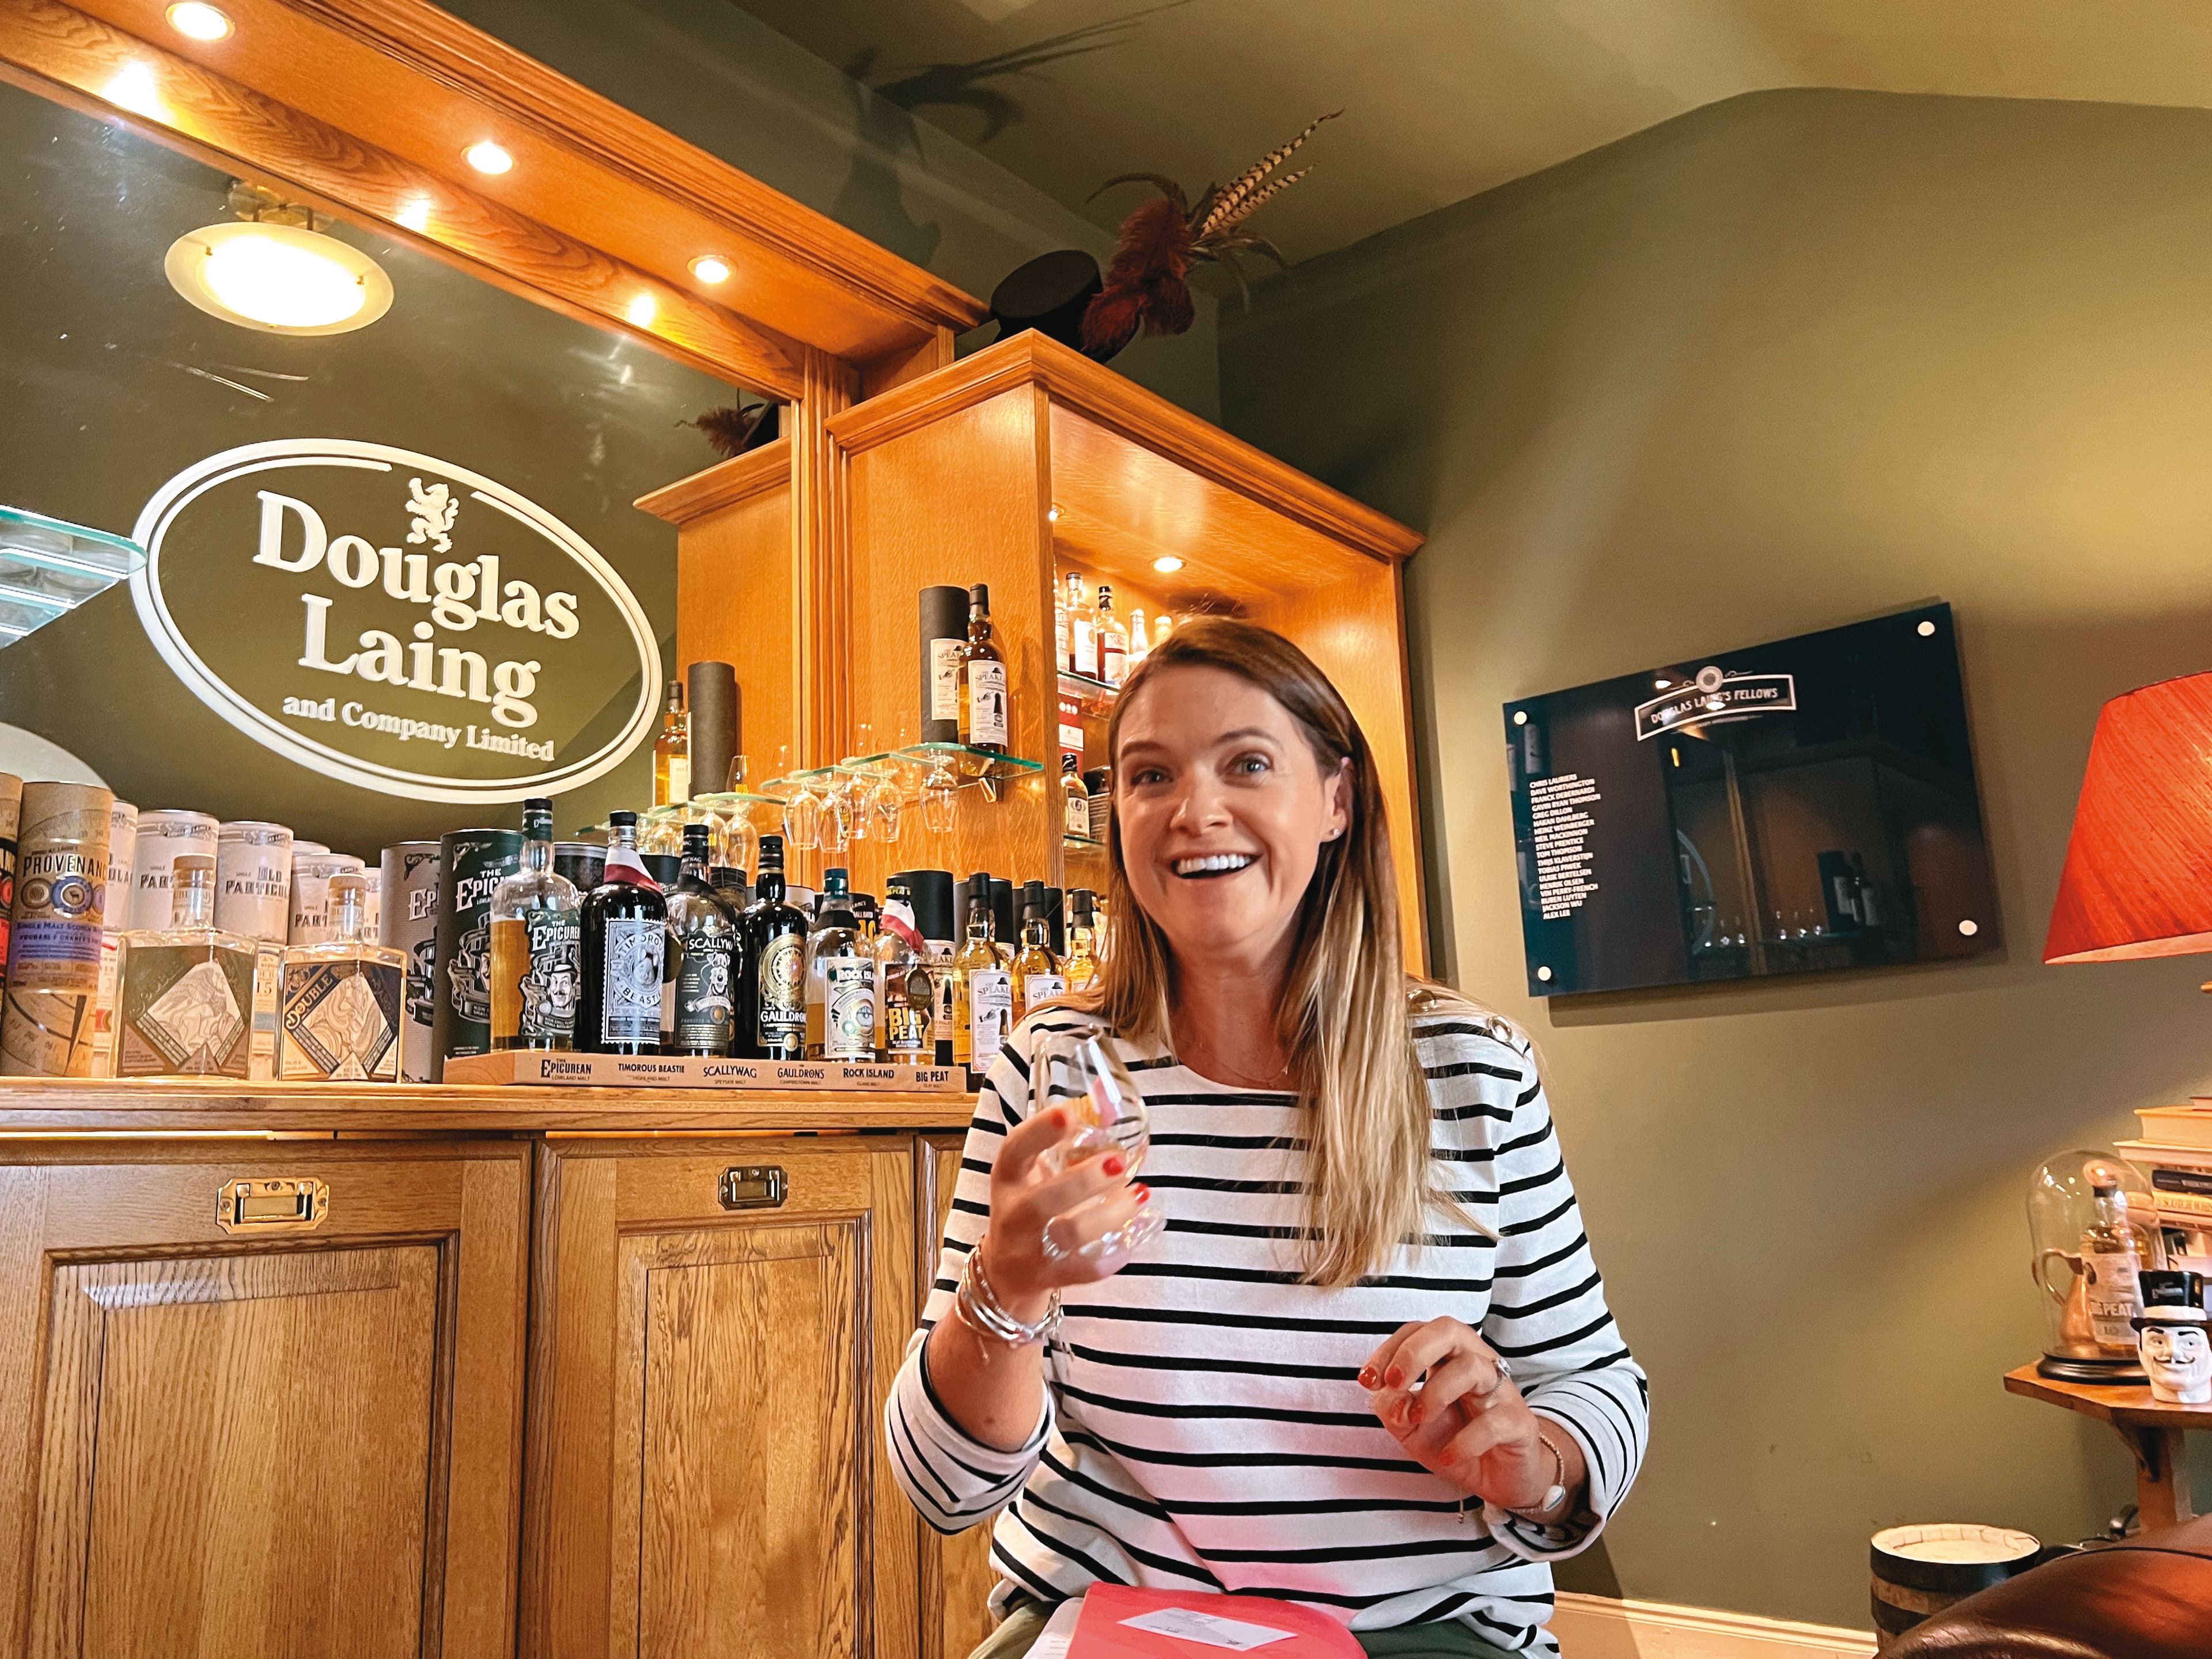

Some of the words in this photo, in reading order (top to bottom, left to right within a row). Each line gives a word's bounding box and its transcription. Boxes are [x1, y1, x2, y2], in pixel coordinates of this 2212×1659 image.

[253, 489, 579, 639] Douglas
[298, 592, 542, 728] Laing
[1650, 700, 1693, 724] DOGLAS
[1734, 688, 1779, 700] FELLOWS
[282, 693, 336, 722] and
[341, 702, 462, 749] Company
[465, 724, 555, 762] Limited
[1531, 788, 1547, 796] DAVE
[1531, 794, 1555, 804] FRANCK
[1532, 802, 1551, 812] GAVIN
[1551, 800, 1569, 808] RYAN
[1569, 793, 1601, 805] THOMSON
[1532, 811, 1550, 820] GREG
[1550, 807, 1573, 816] DILLON
[1555, 812, 1589, 824] DAHLBERG
[1534, 826, 1554, 835] HEINZ
[1553, 819, 1595, 832] WEINBERGER
[1535, 835, 1549, 843] NEIL
[1549, 828, 1588, 840] MACKINNON
[1535, 842, 1554, 851] STEVE
[1554, 837, 1584, 847] PRENTICE
[1536, 850, 1551, 858] TOM
[1551, 845, 1582, 856] THOMSON
[259, 866, 282, 882] OLD
[480, 868, 502, 878] THE
[1537, 865, 1560, 874] TOBIAS
[1539, 873, 1558, 882] ULRIK
[1557, 868, 1592, 880] BERTELSEN
[1539, 881, 1563, 890] HENRIK
[1563, 878, 1584, 887] OLSEN
[1540, 889, 1552, 897] VIN
[1563, 892, 1587, 902] LUYTEN
[1542, 902, 1570, 913] JACKSON
[1543, 911, 1559, 920] ALEX
[839, 968, 863, 980] ROCK
[286, 974, 333, 1030] DOUBLE
[888, 1007, 922, 1027] BIG
[889, 1024, 925, 1040] PEAT
[540, 1059, 592, 1078] EPICUREAN
[618, 1063, 657, 1073] TIMOROUS
[658, 1065, 685, 1073] BEASTIE
[703, 1065, 757, 1078] SCALLYWAG
[777, 1067, 825, 1079] GAULDRONS
[843, 1068, 865, 1078] ROCK
[866, 1069, 895, 1078] ISLAND
[916, 1071, 928, 1082] BIG
[930, 1071, 949, 1082] PEAT
